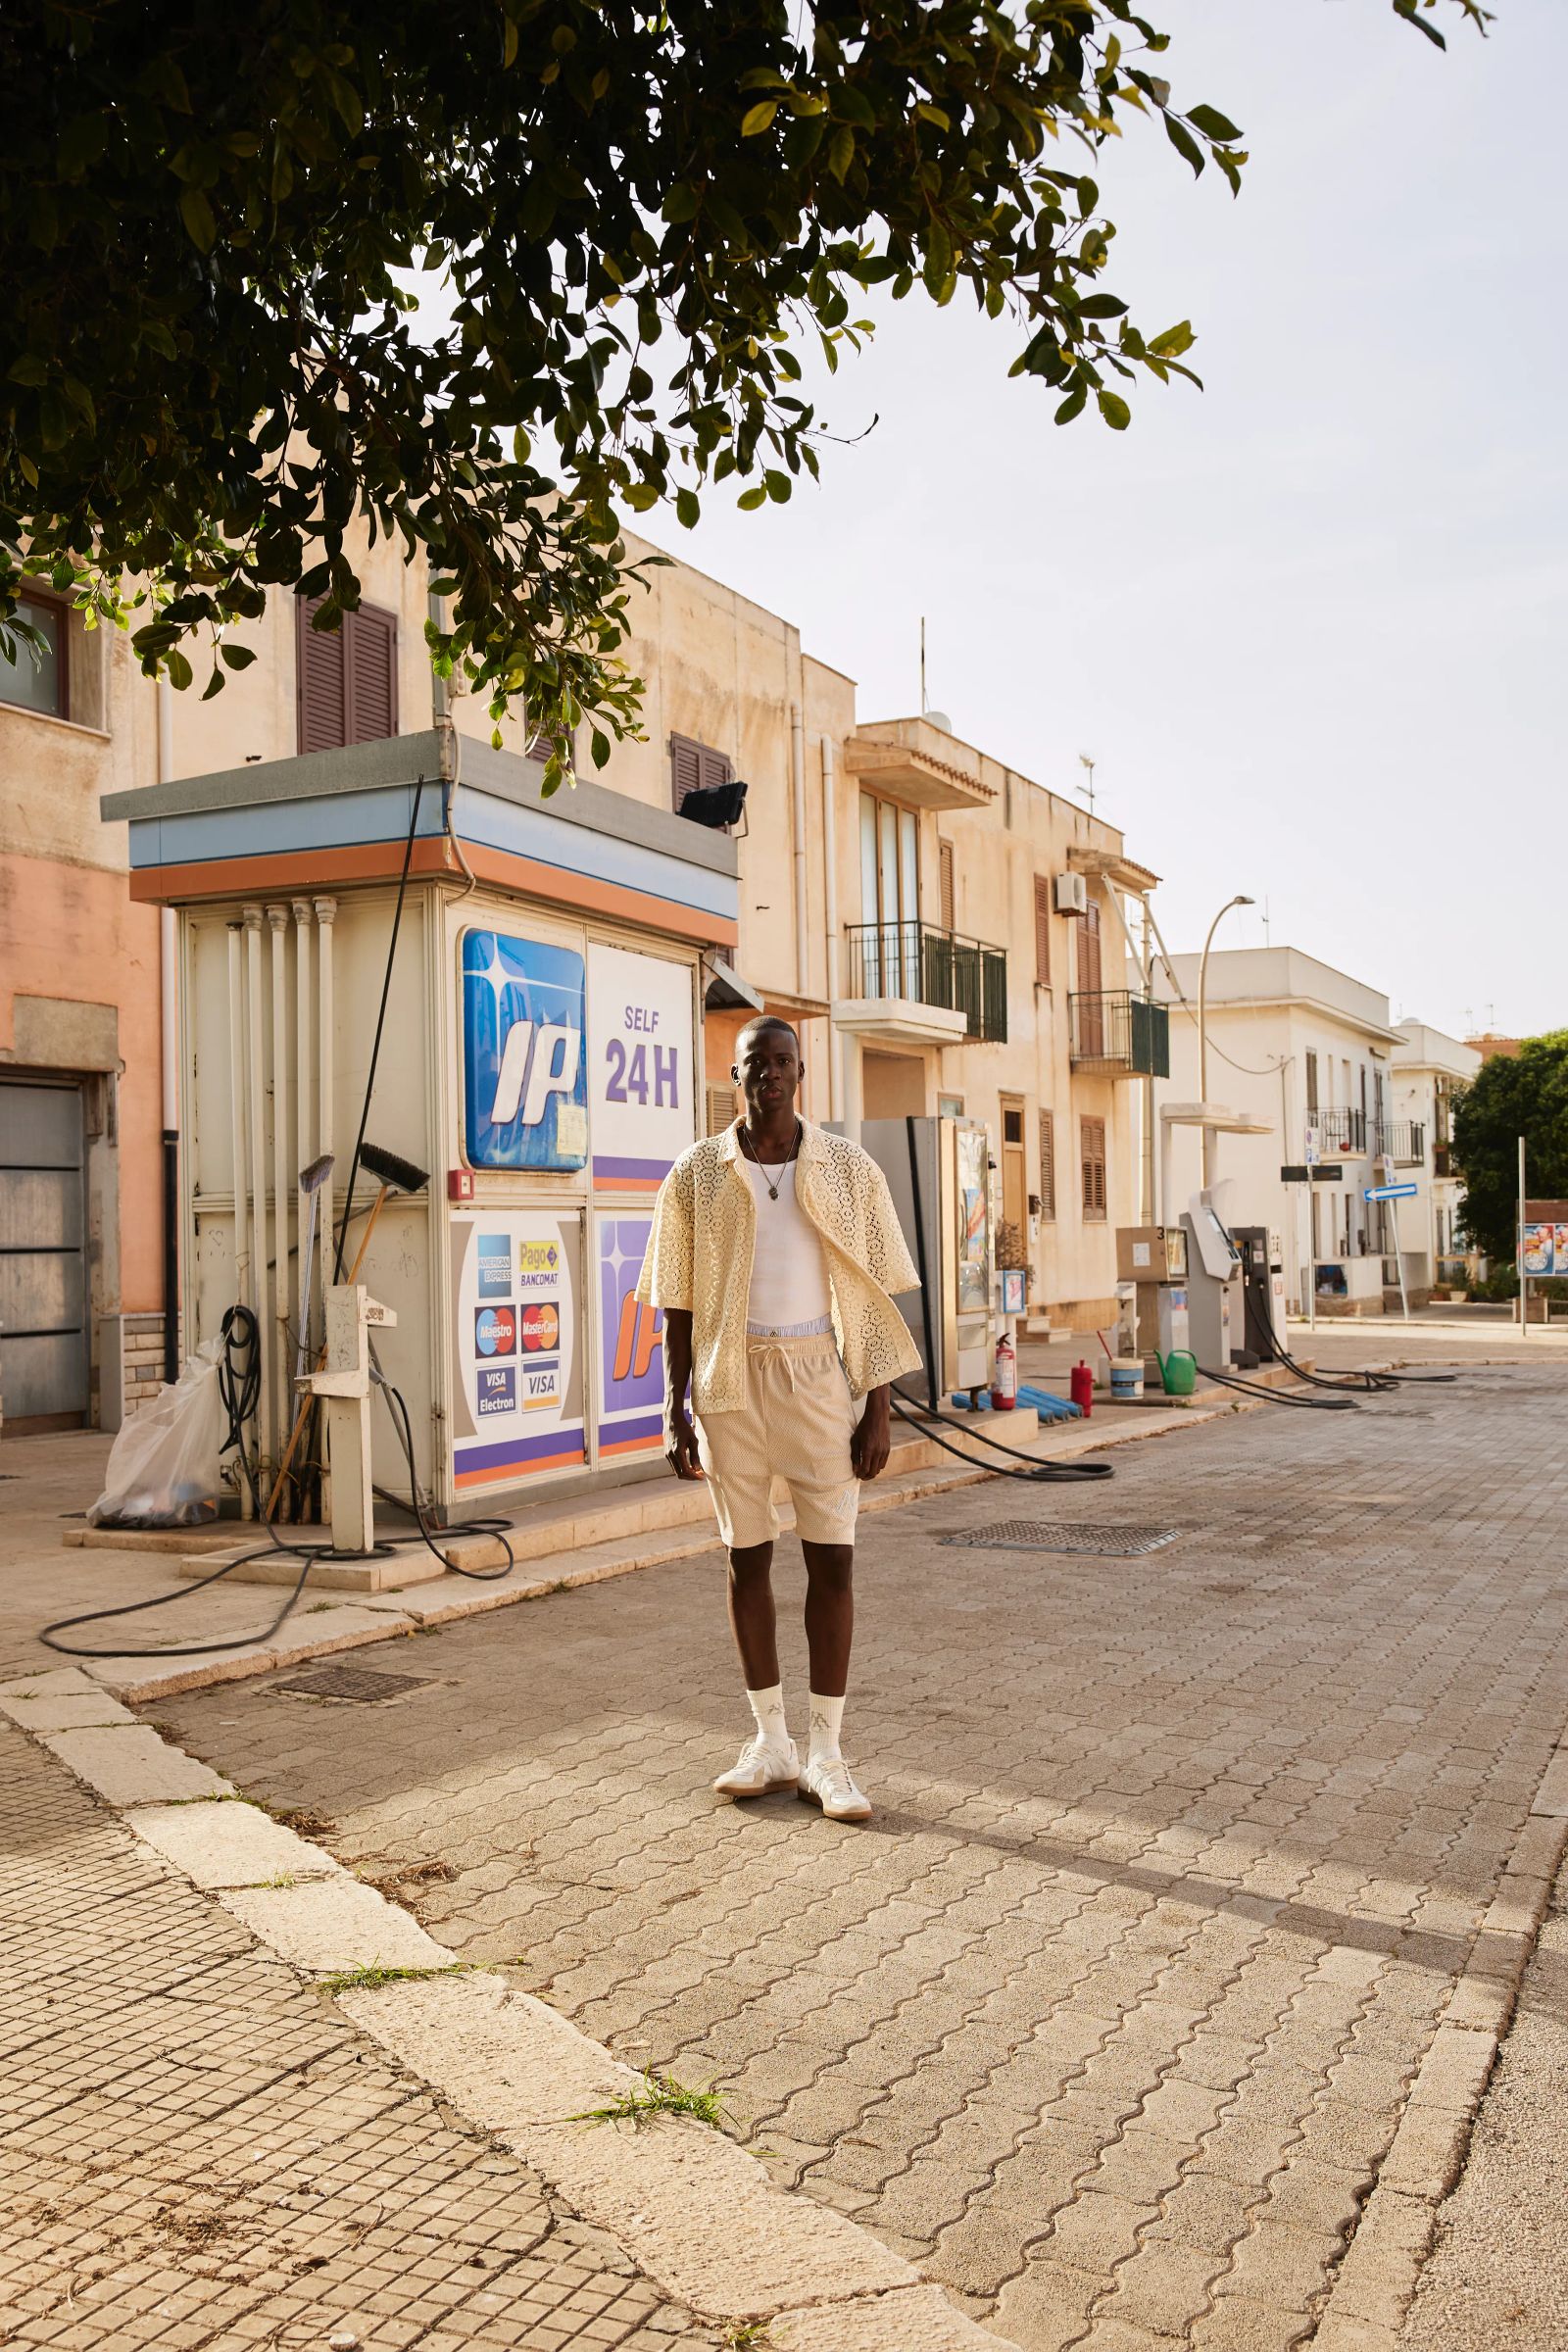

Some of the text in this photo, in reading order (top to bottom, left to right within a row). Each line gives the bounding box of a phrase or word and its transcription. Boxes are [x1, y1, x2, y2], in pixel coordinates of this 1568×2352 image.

[624, 1005, 659, 1034] SELF
[490, 1019, 582, 1126] IP
[606, 1038, 679, 1109] 24H
[1156, 1227, 1164, 1240] 3
[478, 1257, 510, 1268] AMERICAN
[520, 1243, 546, 1270] Pago
[485, 1271, 513, 1282] EXPRESS
[520, 1273, 559, 1287] BANCOMAT
[480, 1324, 512, 1339] Maestro
[522, 1319, 558, 1336] MasterCard
[486, 1372, 507, 1387] VISA
[529, 1375, 555, 1395] VISA
[479, 1397, 514, 1412] Electron
